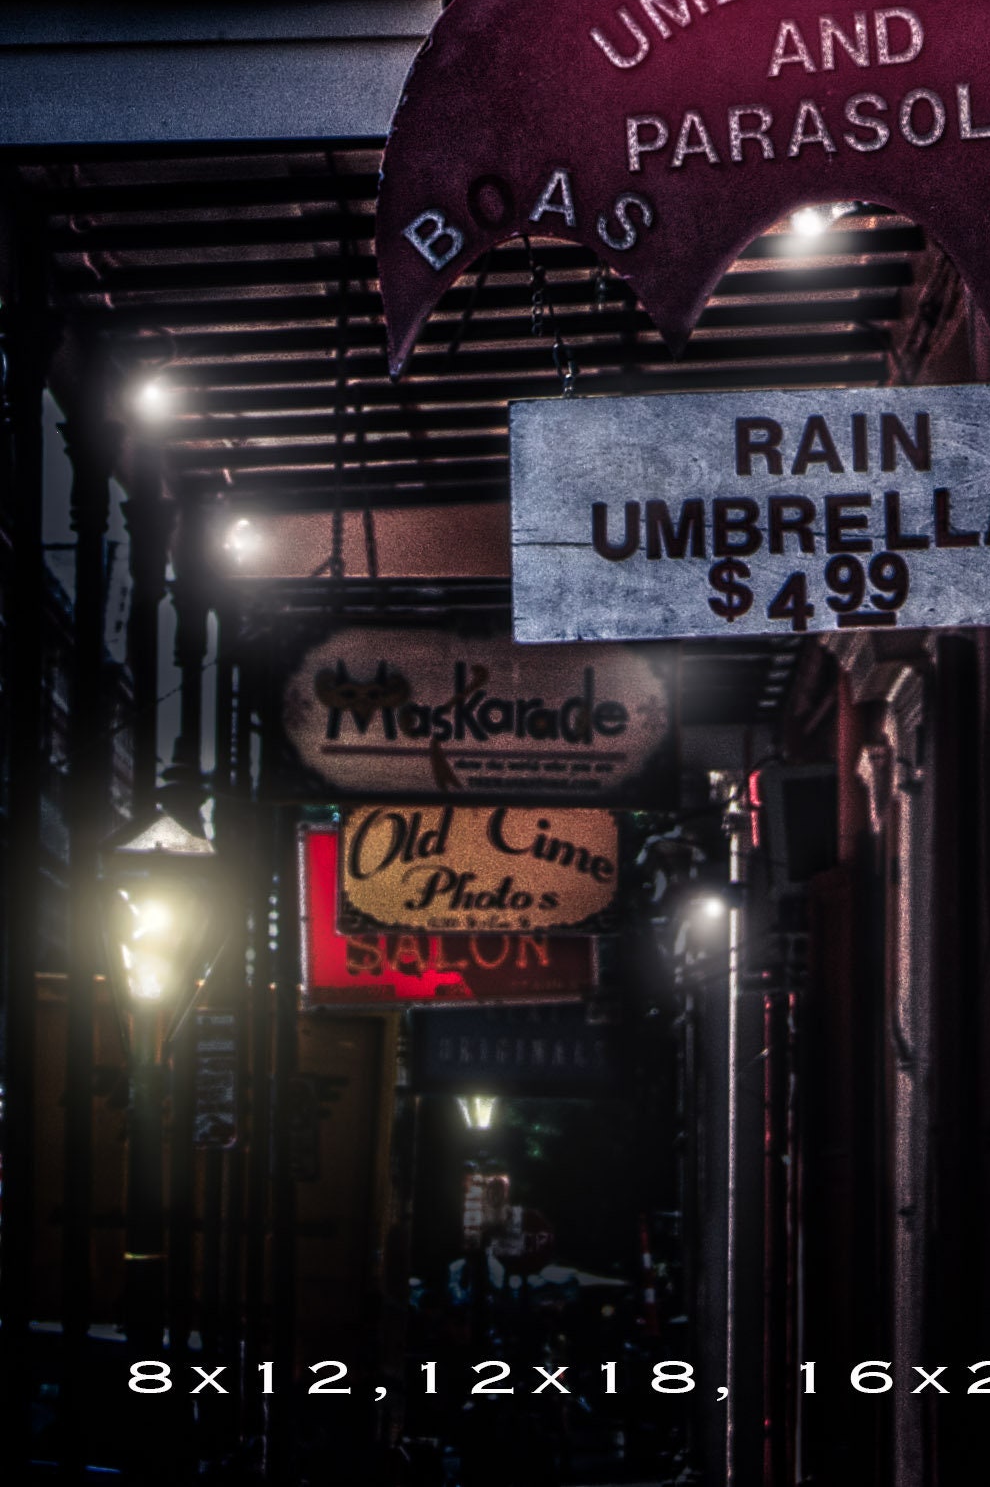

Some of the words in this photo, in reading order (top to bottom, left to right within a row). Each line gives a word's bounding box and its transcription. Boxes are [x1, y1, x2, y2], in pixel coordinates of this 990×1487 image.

[767, 6, 925, 79] AND
[734, 412, 931, 476] RAIN
[324, 659, 630, 745] Maskarade
[349, 805, 452, 881] Old
[402, 864, 559, 911] Photos
